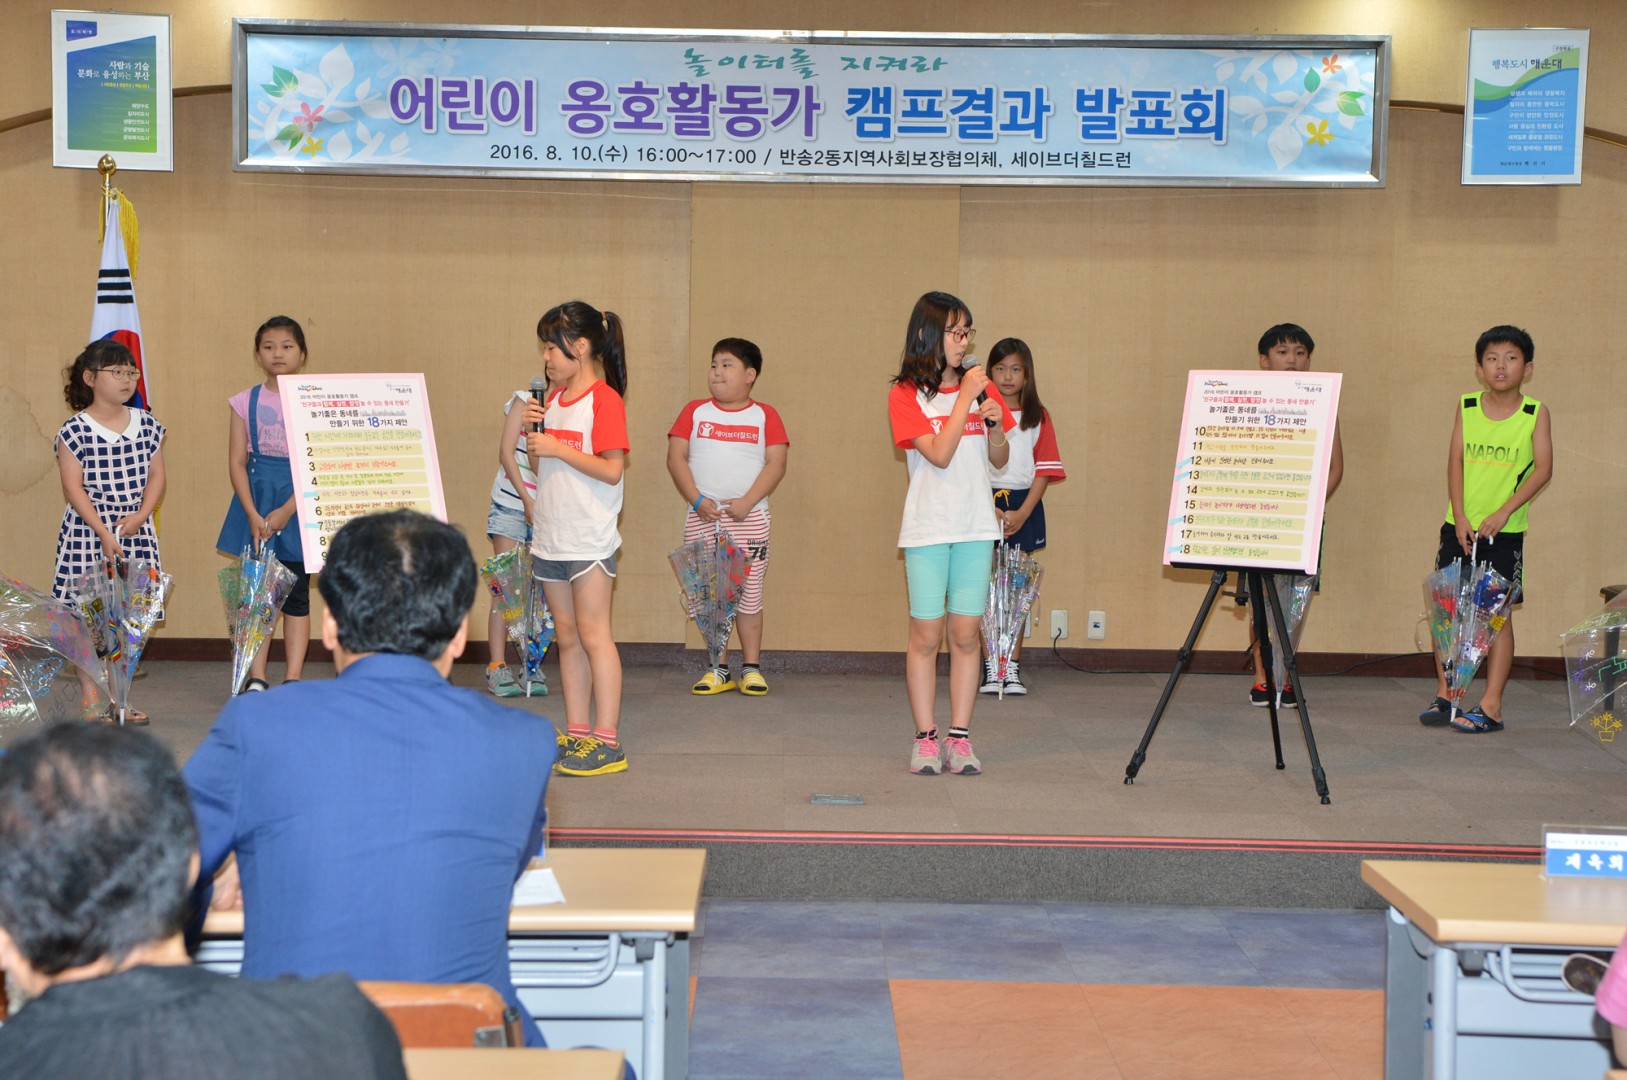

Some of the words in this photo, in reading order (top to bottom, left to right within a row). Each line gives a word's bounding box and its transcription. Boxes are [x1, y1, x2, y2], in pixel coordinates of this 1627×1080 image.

[109, 61, 131, 71] 사람과
[134, 62, 150, 71] 기술
[683, 47, 820, 80] 놀이터를
[840, 55, 948, 73] 지켜라
[1492, 59, 1528, 70] 행복도시
[77, 69, 100, 78] 문화로
[102, 70, 132, 80] 융성하는
[134, 72, 150, 81] 부산
[390, 78, 534, 132] 어린이
[561, 81, 821, 139] 옹호활동가
[847, 86, 1052, 140] 캠프결과
[1075, 87, 1225, 142] 발표회
[490, 144, 538, 160] 2016.
[546, 145, 562, 161] 8.
[572, 145, 628, 163] 10.(수)
[637, 147, 756, 164] 16:00~17:00
[763, 149, 771, 165] /
[780, 149, 1002, 168] 반송2동지역사회보장협의체,
[1011, 151, 1131, 168] 세이브더칠드런
[311, 410, 337, 418] 놀기좋은
[340, 409, 359, 417] 동네를
[1209, 406, 1235, 414] 놀기좋은
[1237, 406, 1257, 414] 동네를
[329, 420, 350, 428] 만들기
[395, 419, 408, 427] 제안
[1225, 416, 1245, 424] 만들기
[1247, 416, 1260, 424] 위한
[1292, 417, 1307, 426] 제안
[715, 430, 759, 440] 세이브더칠드런
[1194, 427, 1206, 436] 10
[305, 433, 310, 442] 1
[1193, 442, 1203, 450] 11
[307, 447, 313, 456] 2
[1466, 443, 1519, 464] NAPOLI
[1191, 456, 1202, 465] 12
[309, 462, 316, 471] 3
[1188, 471, 1200, 480] 13
[311, 477, 318, 485] 4
[1186, 486, 1198, 495] 14
[1184, 500, 1196, 509] 15
[315, 506, 322, 516] 6
[1183, 515, 1194, 524] 16
[317, 522, 323, 531] 7
[1180, 530, 1192, 539] 17
[320, 536, 326, 546] 8
[748, 546, 767, 561] 78
